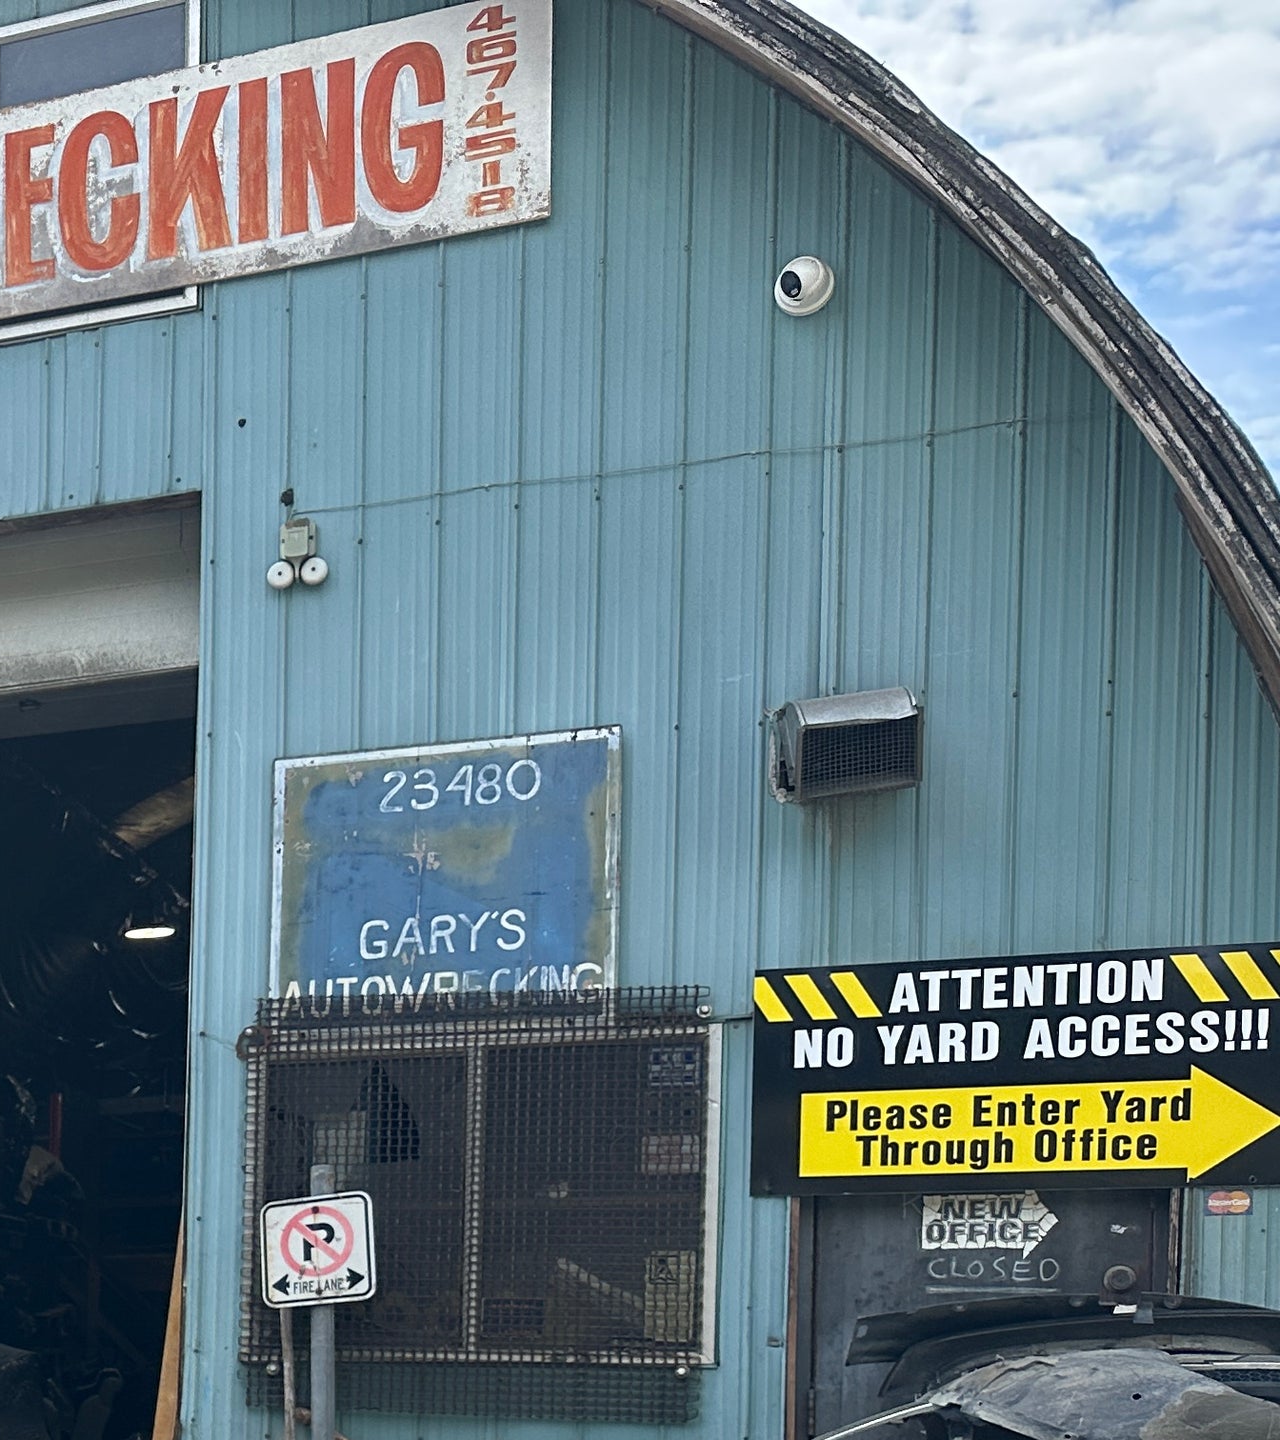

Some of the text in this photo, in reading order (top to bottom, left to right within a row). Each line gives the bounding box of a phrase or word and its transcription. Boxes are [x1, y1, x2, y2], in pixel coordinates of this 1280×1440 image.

[379, 759, 541, 813] 23480
[359, 908, 527, 960] GARY'S
[888, 958, 1164, 1014] ATTENTION
[793, 1008, 1270, 1069] NO YARD ACCESS!!!
[826, 1087, 1192, 1132] Please Enter Yard
[855, 1128, 1158, 1170] Through Office
[942, 1198, 1024, 1220] NEW
[926, 1219, 1041, 1243] OFFICE
[294, 1281, 314, 1294] FIRE
[928, 1257, 1059, 1281] CLOSED
